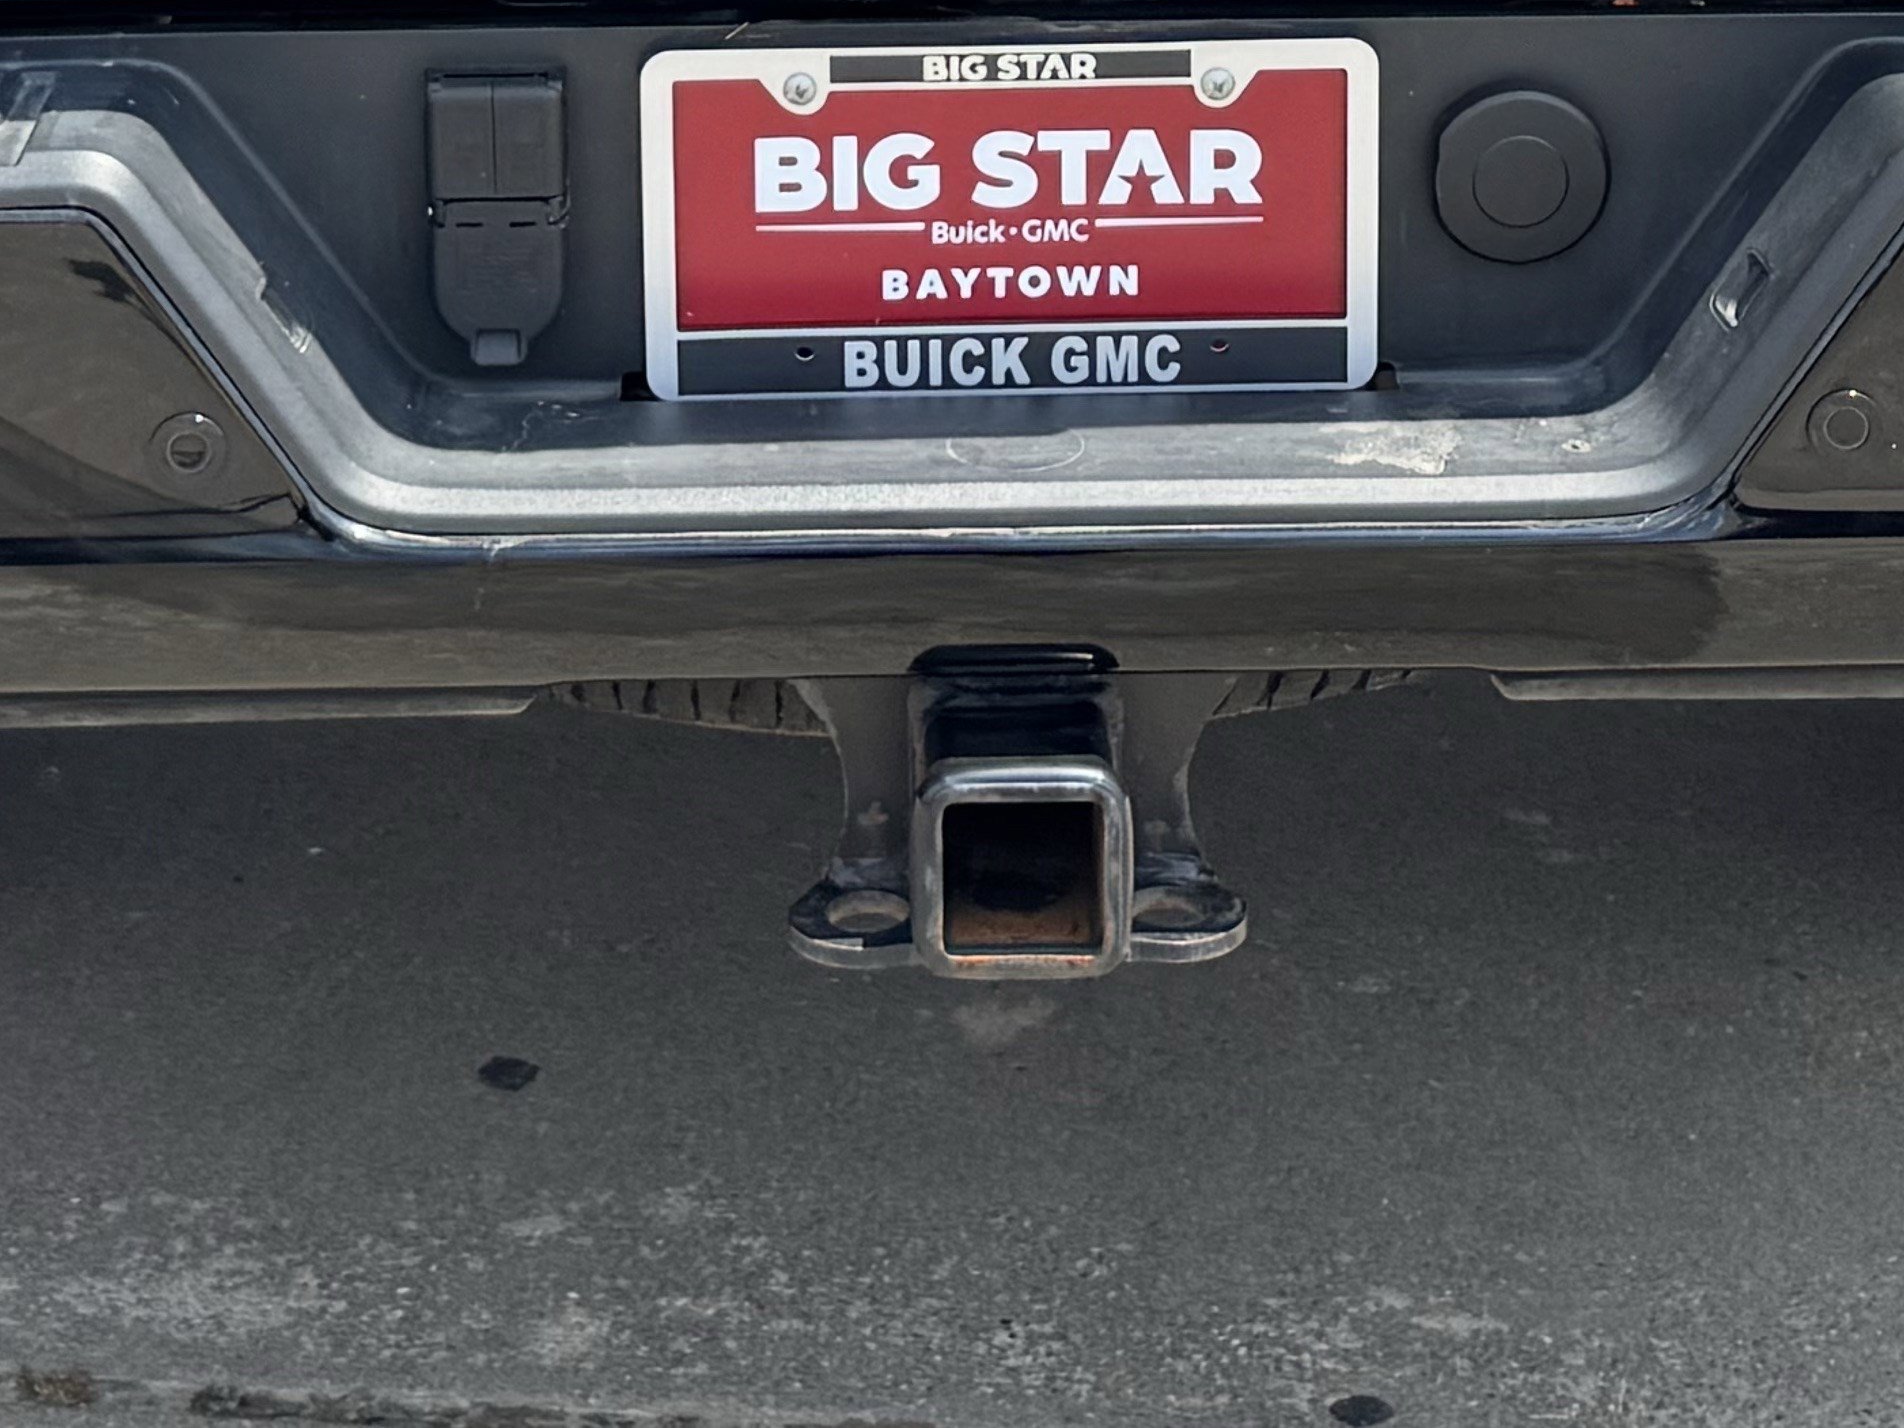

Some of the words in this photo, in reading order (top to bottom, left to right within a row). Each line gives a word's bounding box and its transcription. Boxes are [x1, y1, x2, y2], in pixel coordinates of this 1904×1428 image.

[922, 54, 987, 82] BIG
[996, 52, 1097, 81] STAR
[753, 133, 941, 214] BIG
[970, 128, 1264, 209] STAR
[881, 264, 1140, 301] BAYTOWN
[843, 337, 1031, 389] BUICK
[1051, 334, 1182, 385] GMC
